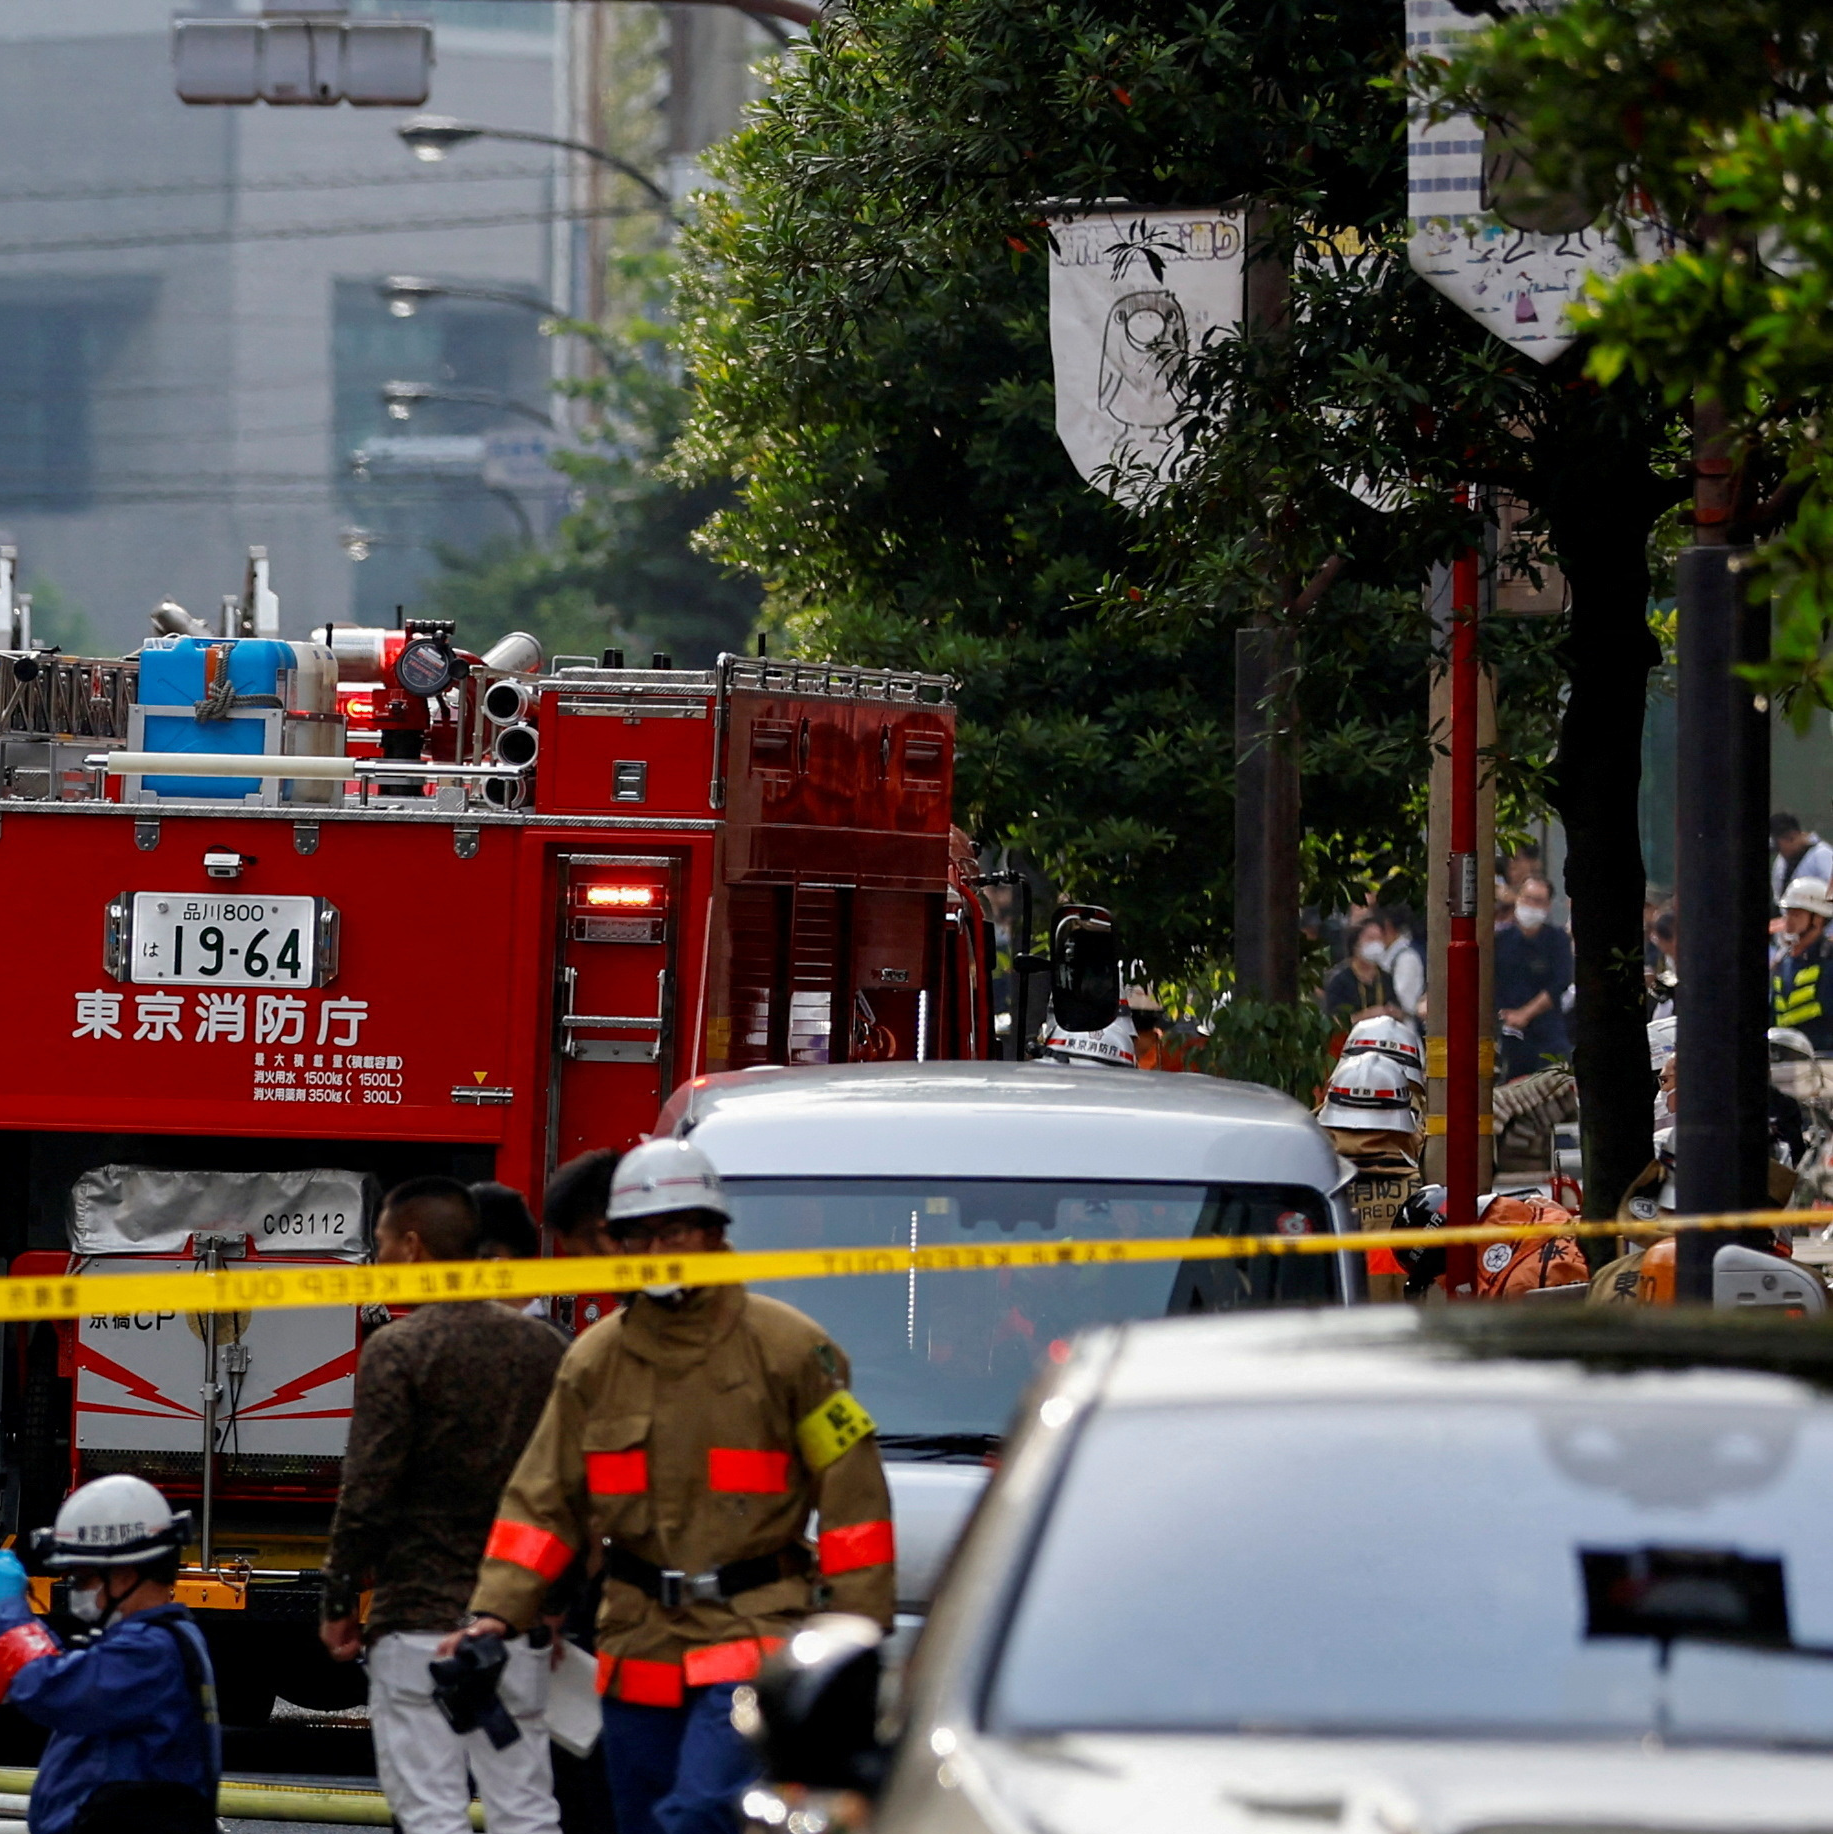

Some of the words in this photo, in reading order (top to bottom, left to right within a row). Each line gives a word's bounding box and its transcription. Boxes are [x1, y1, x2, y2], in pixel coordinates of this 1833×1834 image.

[183, 903, 264, 922] 品川800
[173, 925, 301, 979] 19-64
[72, 989, 368, 1047] 東京消防庁
[1067, 1038, 1118, 1057] 東京消防庁
[254, 1070, 296, 1084] 消火用水
[253, 1087, 306, 1101] 消火用薬剤
[263, 1212, 346, 1236] C03112
